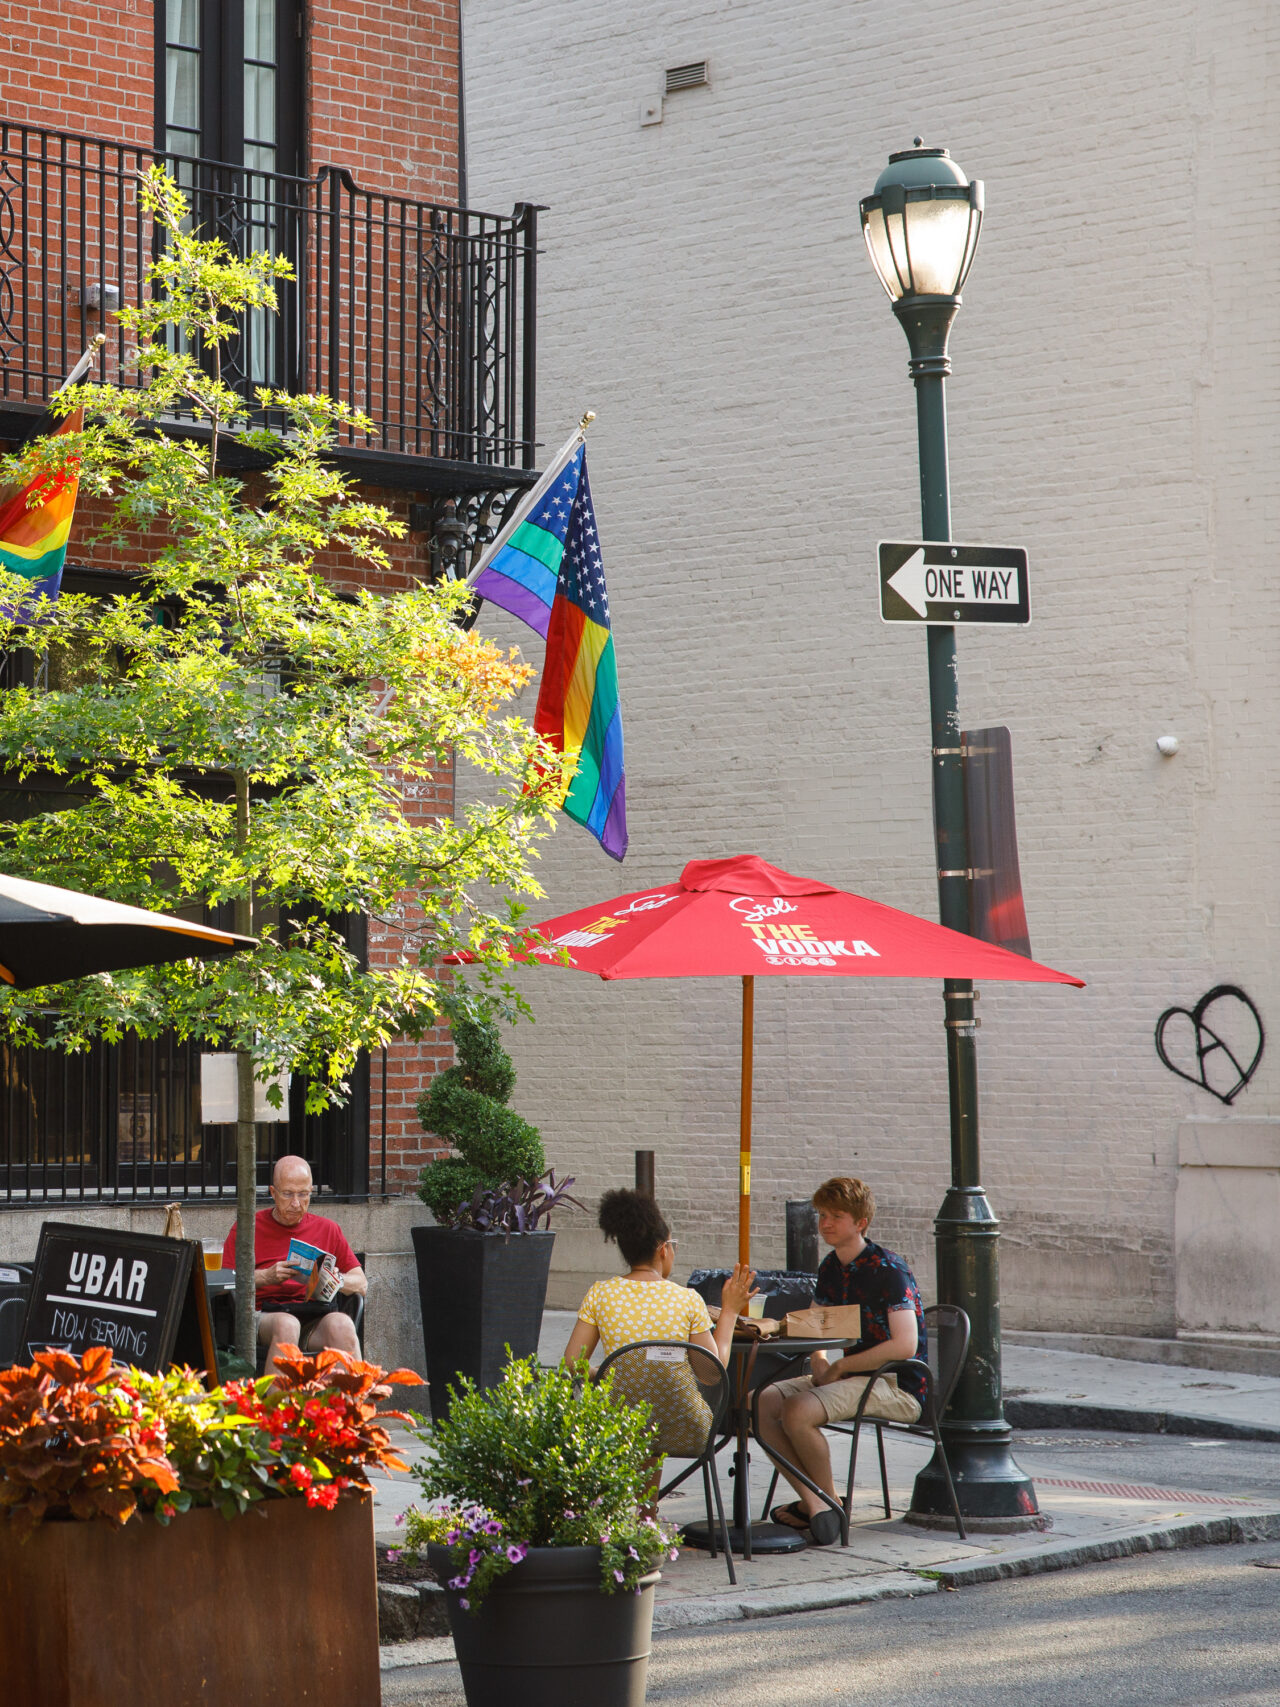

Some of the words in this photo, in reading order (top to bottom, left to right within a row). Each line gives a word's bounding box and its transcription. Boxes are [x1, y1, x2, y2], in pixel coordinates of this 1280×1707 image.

[925, 568, 965, 598] ONE
[972, 570, 1013, 600] WAY
[729, 896, 799, 922] Stoli
[740, 923, 819, 941] THE
[752, 938, 881, 957] VODKA
[66, 1251, 149, 1303] UBAR
[51, 1308, 88, 1341] NOW
[90, 1317, 148, 1357] SERVING
